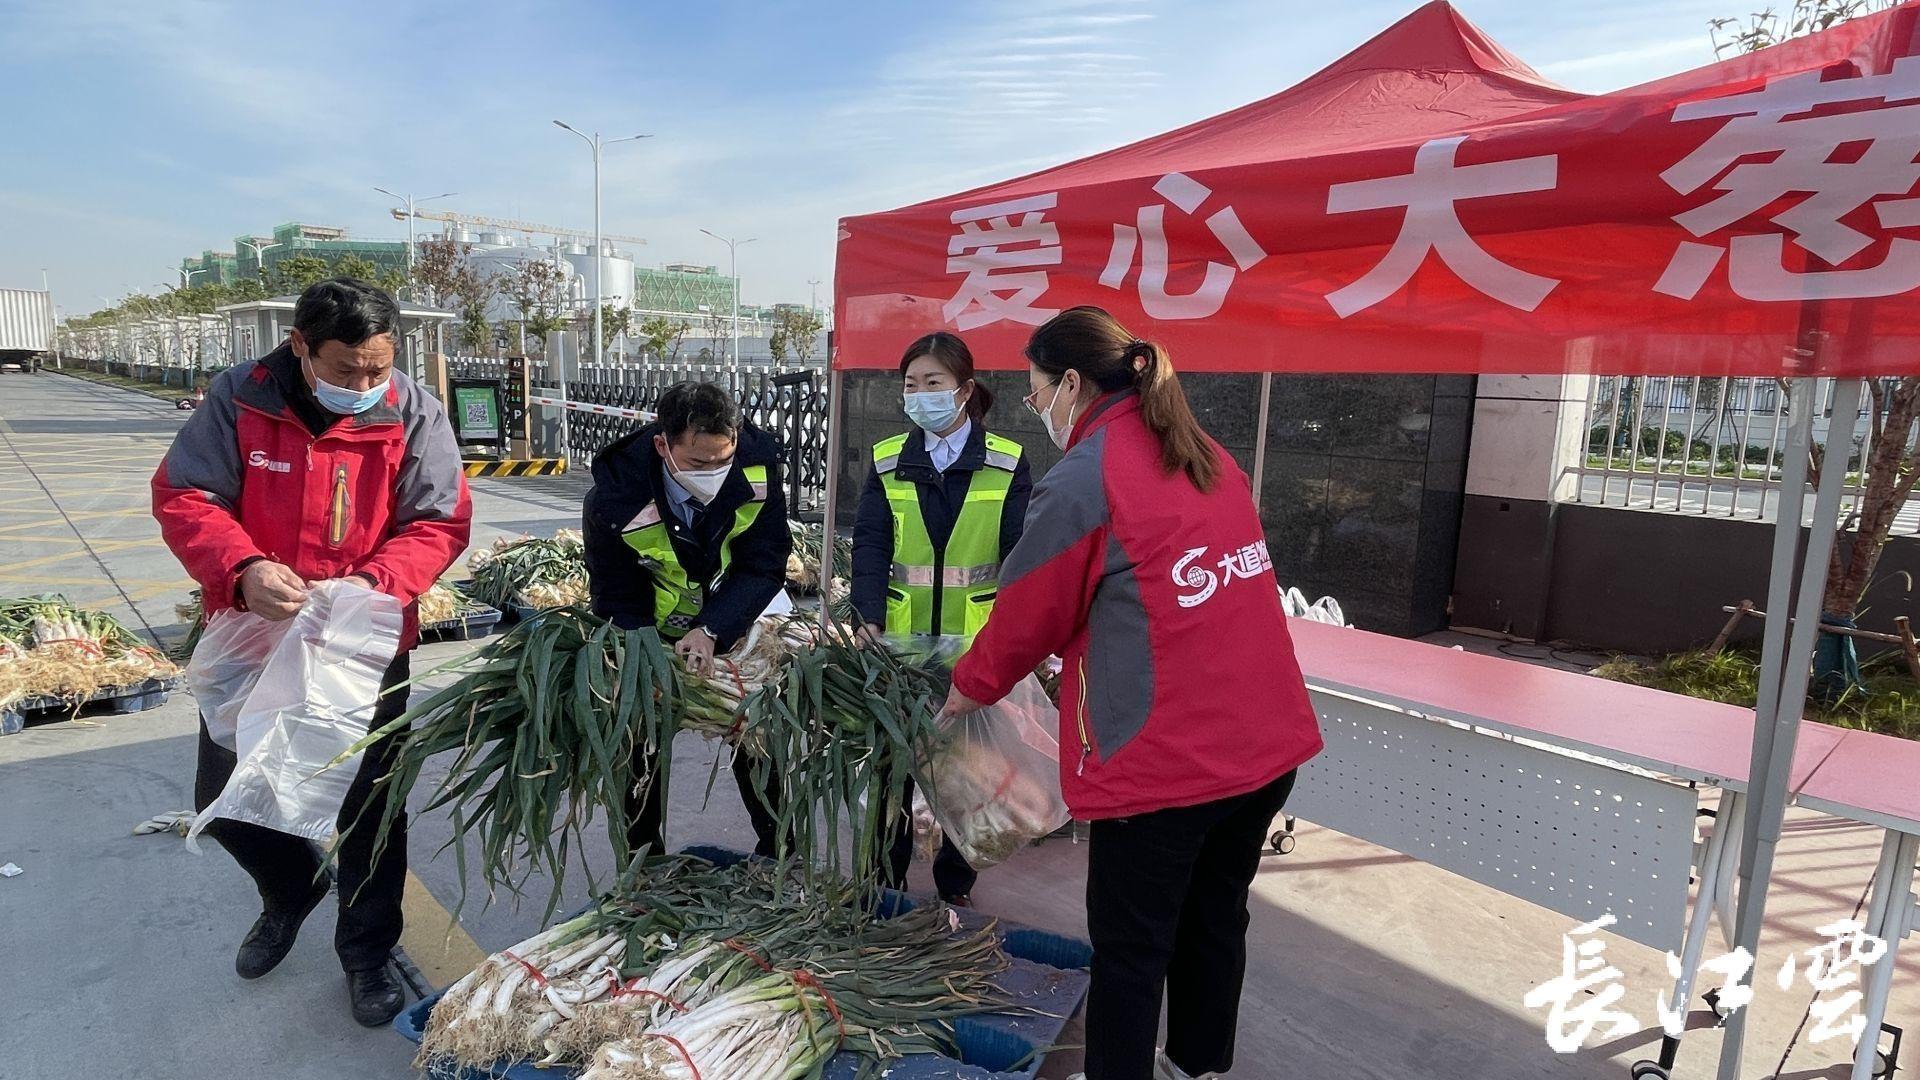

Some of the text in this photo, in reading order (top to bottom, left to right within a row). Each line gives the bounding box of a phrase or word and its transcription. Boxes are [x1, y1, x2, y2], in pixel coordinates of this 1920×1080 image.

[943, 55, 1920, 332] 爱心大葱
[514, 409, 522, 420] P
